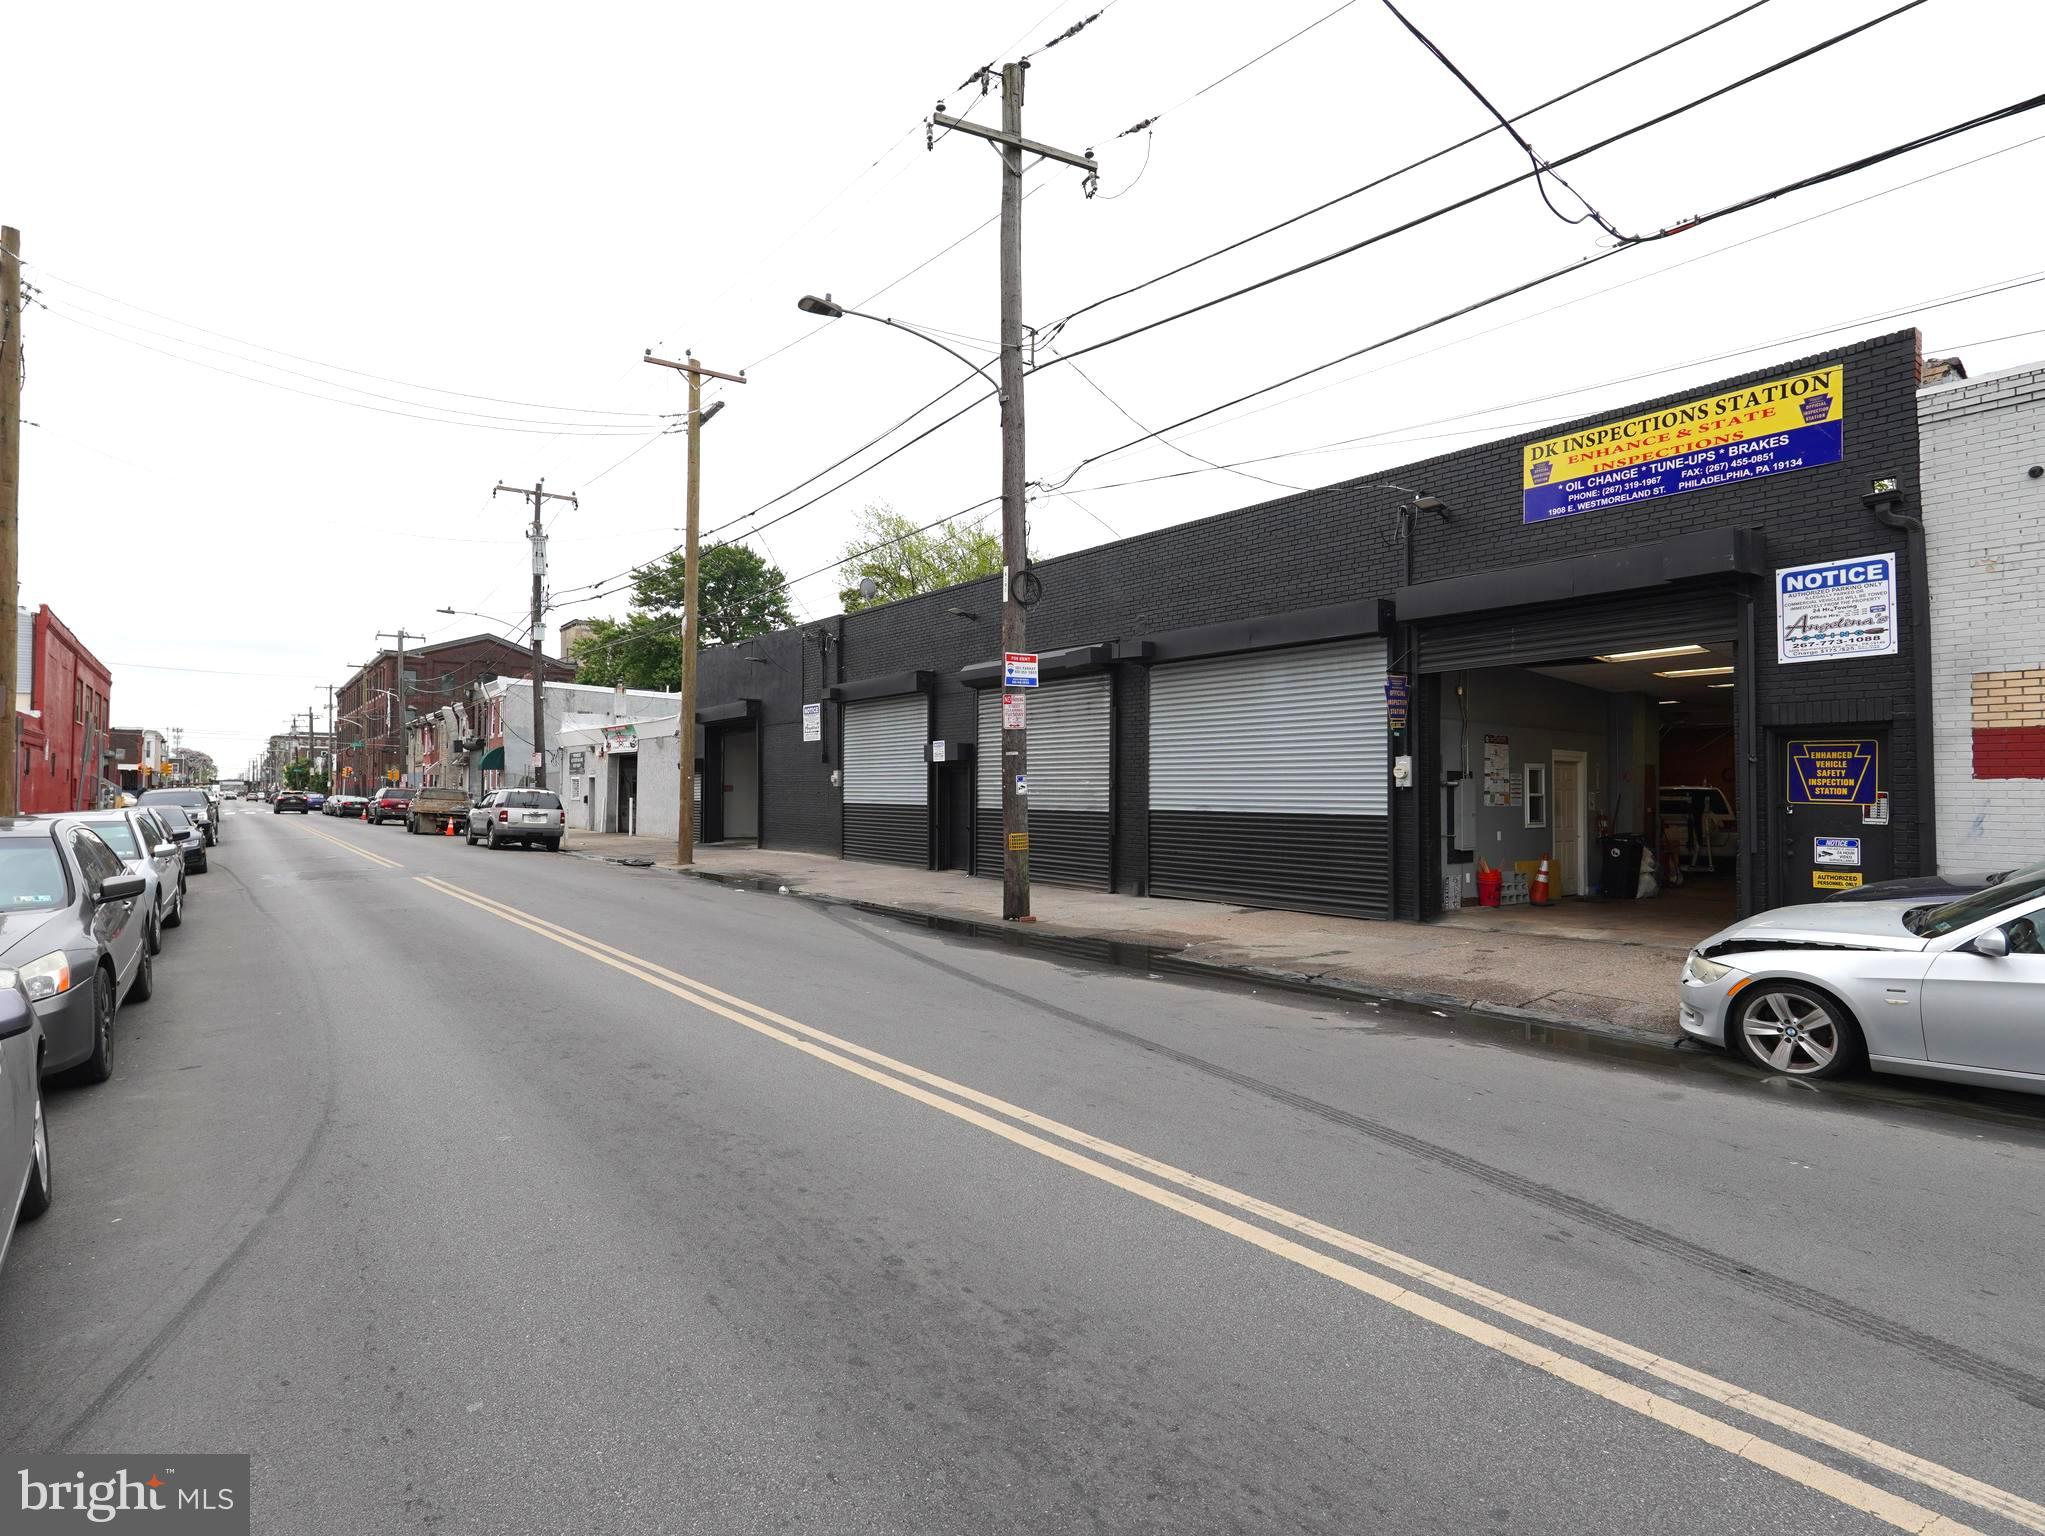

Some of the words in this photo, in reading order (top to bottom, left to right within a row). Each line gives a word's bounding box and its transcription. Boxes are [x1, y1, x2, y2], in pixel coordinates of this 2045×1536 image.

[1531, 444, 1559, 461] DK
[1563, 403, 1709, 453] INSPECTIONS
[1715, 371, 1832, 416] STATION
[1568, 433, 1670, 464] ENHANCE
[1676, 428, 1692, 439] &
[1698, 407, 1776, 433] STATE
[1566, 481, 1584, 492] OIL
[1587, 468, 1639, 487] CHANGE
[1650, 451, 1716, 474] TUNE-UPS
[1728, 435, 1790, 457] BRAKES
[1593, 430, 1744, 473] INSPECTIONS
[1549, 507, 1566, 516] 1908
[1568, 504, 1575, 512] E.
[1577, 490, 1650, 510] WESTMORELAND
[1653, 486, 1666, 494] ST.
[1678, 469, 1753, 490] PHILADELPHIA,
[1756, 465, 1770, 474] PA
[1772, 458, 1803, 471] 19134
[1568, 490, 1601, 502] PHONE:
[1602, 485, 1622, 497] (267)
[1624, 476, 1662, 490] 319-1967
[1681, 469, 1703, 478] FAX:
[1705, 462, 1728, 475] (267)
[1730, 452, 1774, 468] 455-0851
[1786, 564, 1883, 591] NOTICE
[1788, 588, 1830, 598] AUTHORIZED
[1831, 584, 1862, 593] PARKING
[1852, 596, 1881, 604] PROPERTY
[1792, 635, 1881, 649] 267-773-1088
[1815, 787, 1848, 795] STATION
